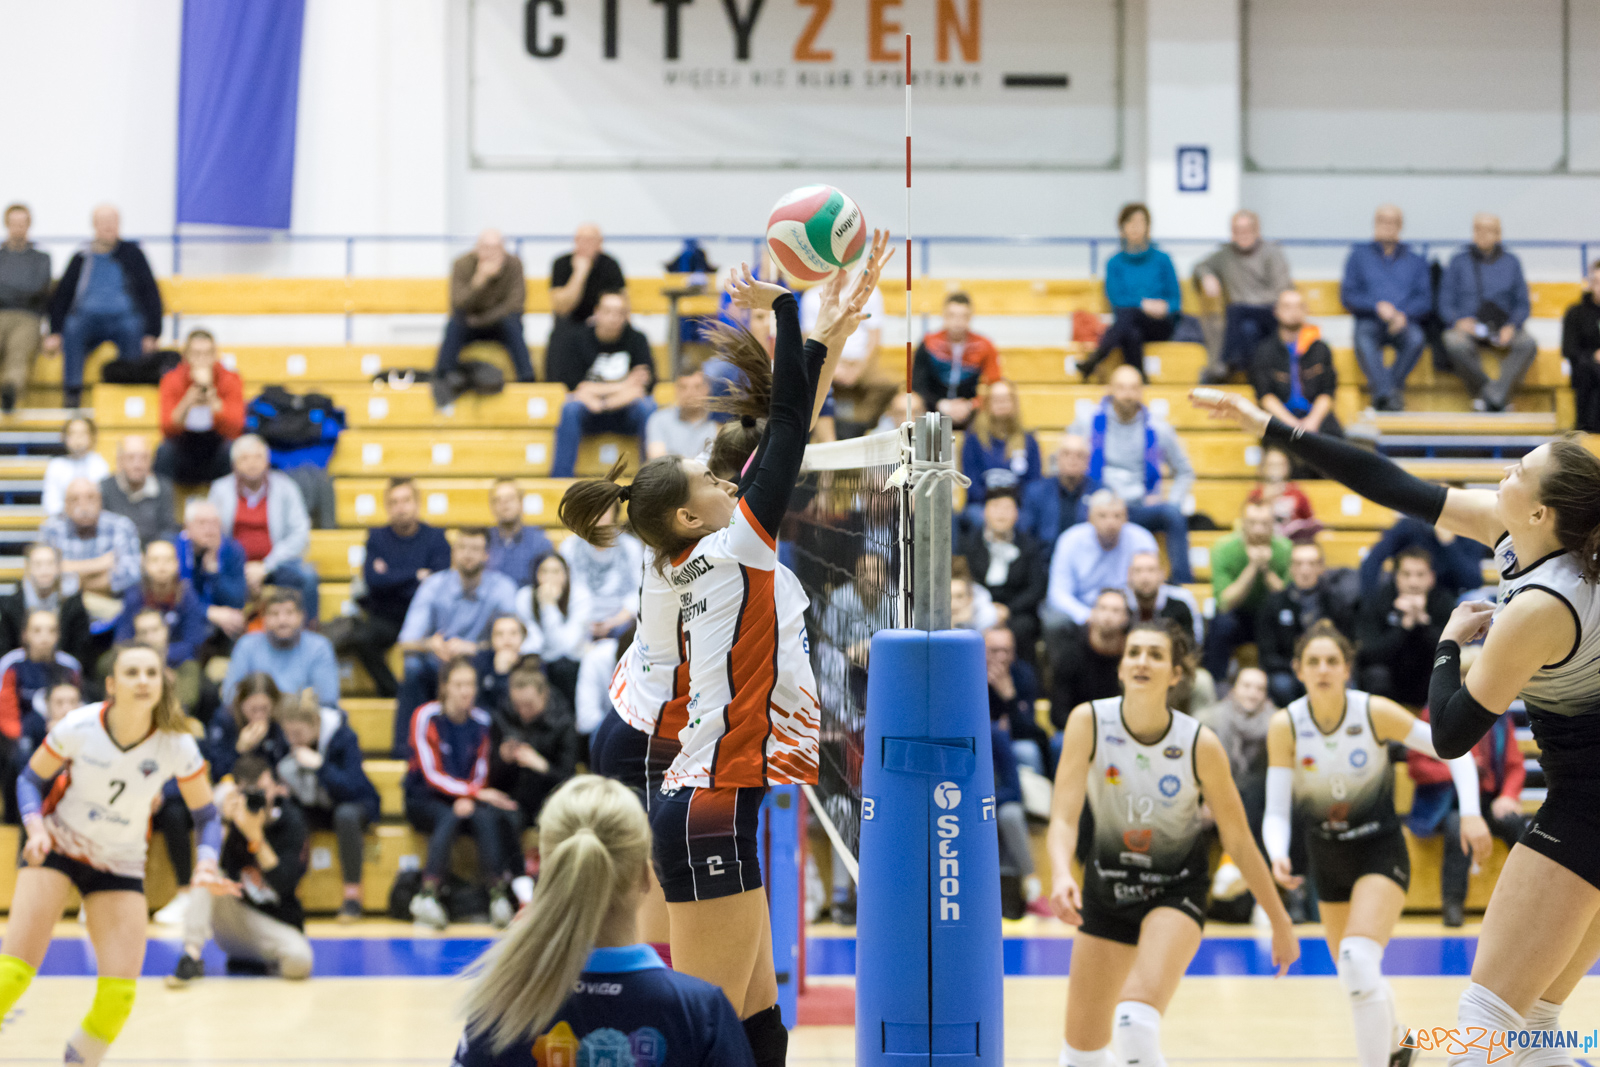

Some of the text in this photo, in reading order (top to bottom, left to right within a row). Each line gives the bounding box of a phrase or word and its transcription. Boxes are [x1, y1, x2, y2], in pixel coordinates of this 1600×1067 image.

[524, 0, 981, 62] CITYZEN
[834, 207, 858, 238] molten
[1125, 793, 1154, 823] 12
[706, 855, 726, 876] 2
[936, 814, 961, 921] Senoh
